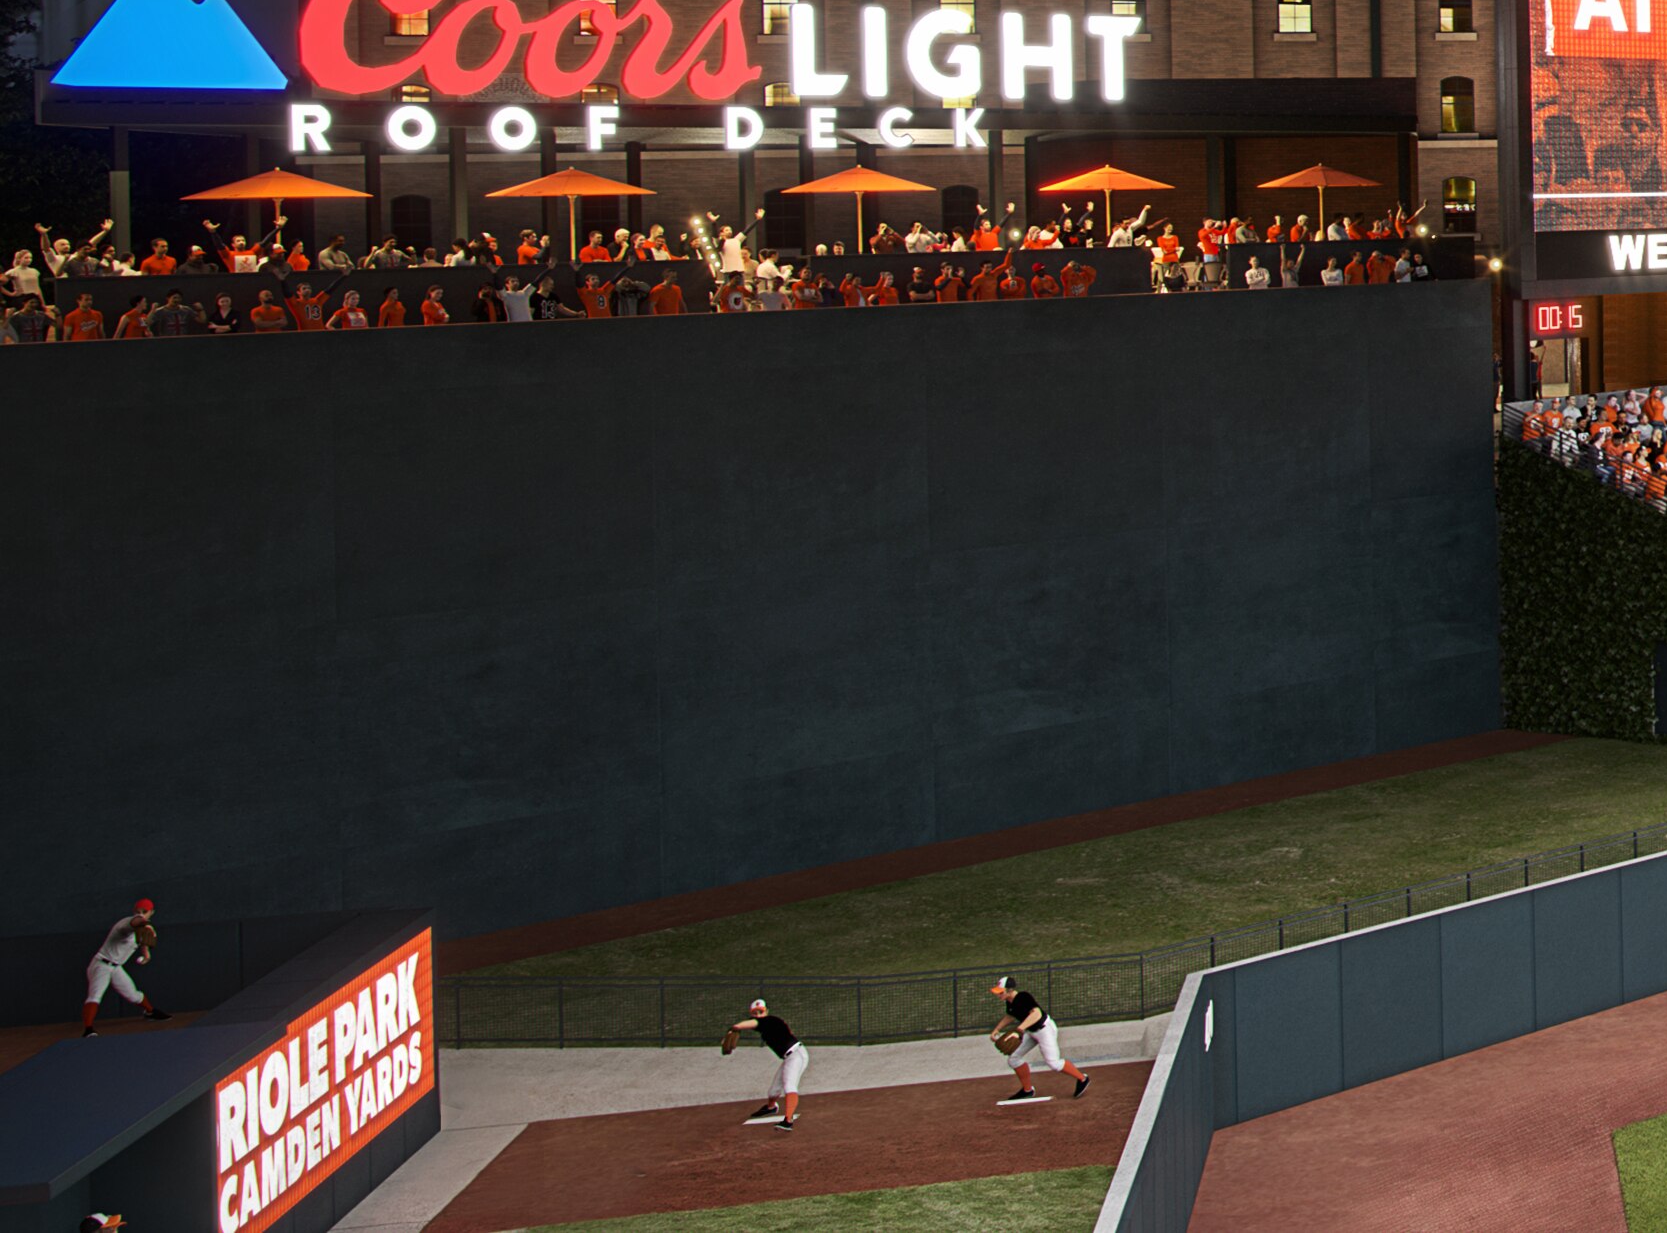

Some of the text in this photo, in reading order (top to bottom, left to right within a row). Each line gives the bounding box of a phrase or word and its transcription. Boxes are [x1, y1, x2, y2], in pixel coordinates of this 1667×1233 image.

[790, 3, 1143, 102] LIGHT
[288, 104, 990, 153] ROOF DECK
[304, 303, 322, 321] 13
[1539, 304, 1583, 330] 00:15
[334, 951, 421, 1085] PARK
[219, 1030, 422, 1233] CAMDEN YARDS
